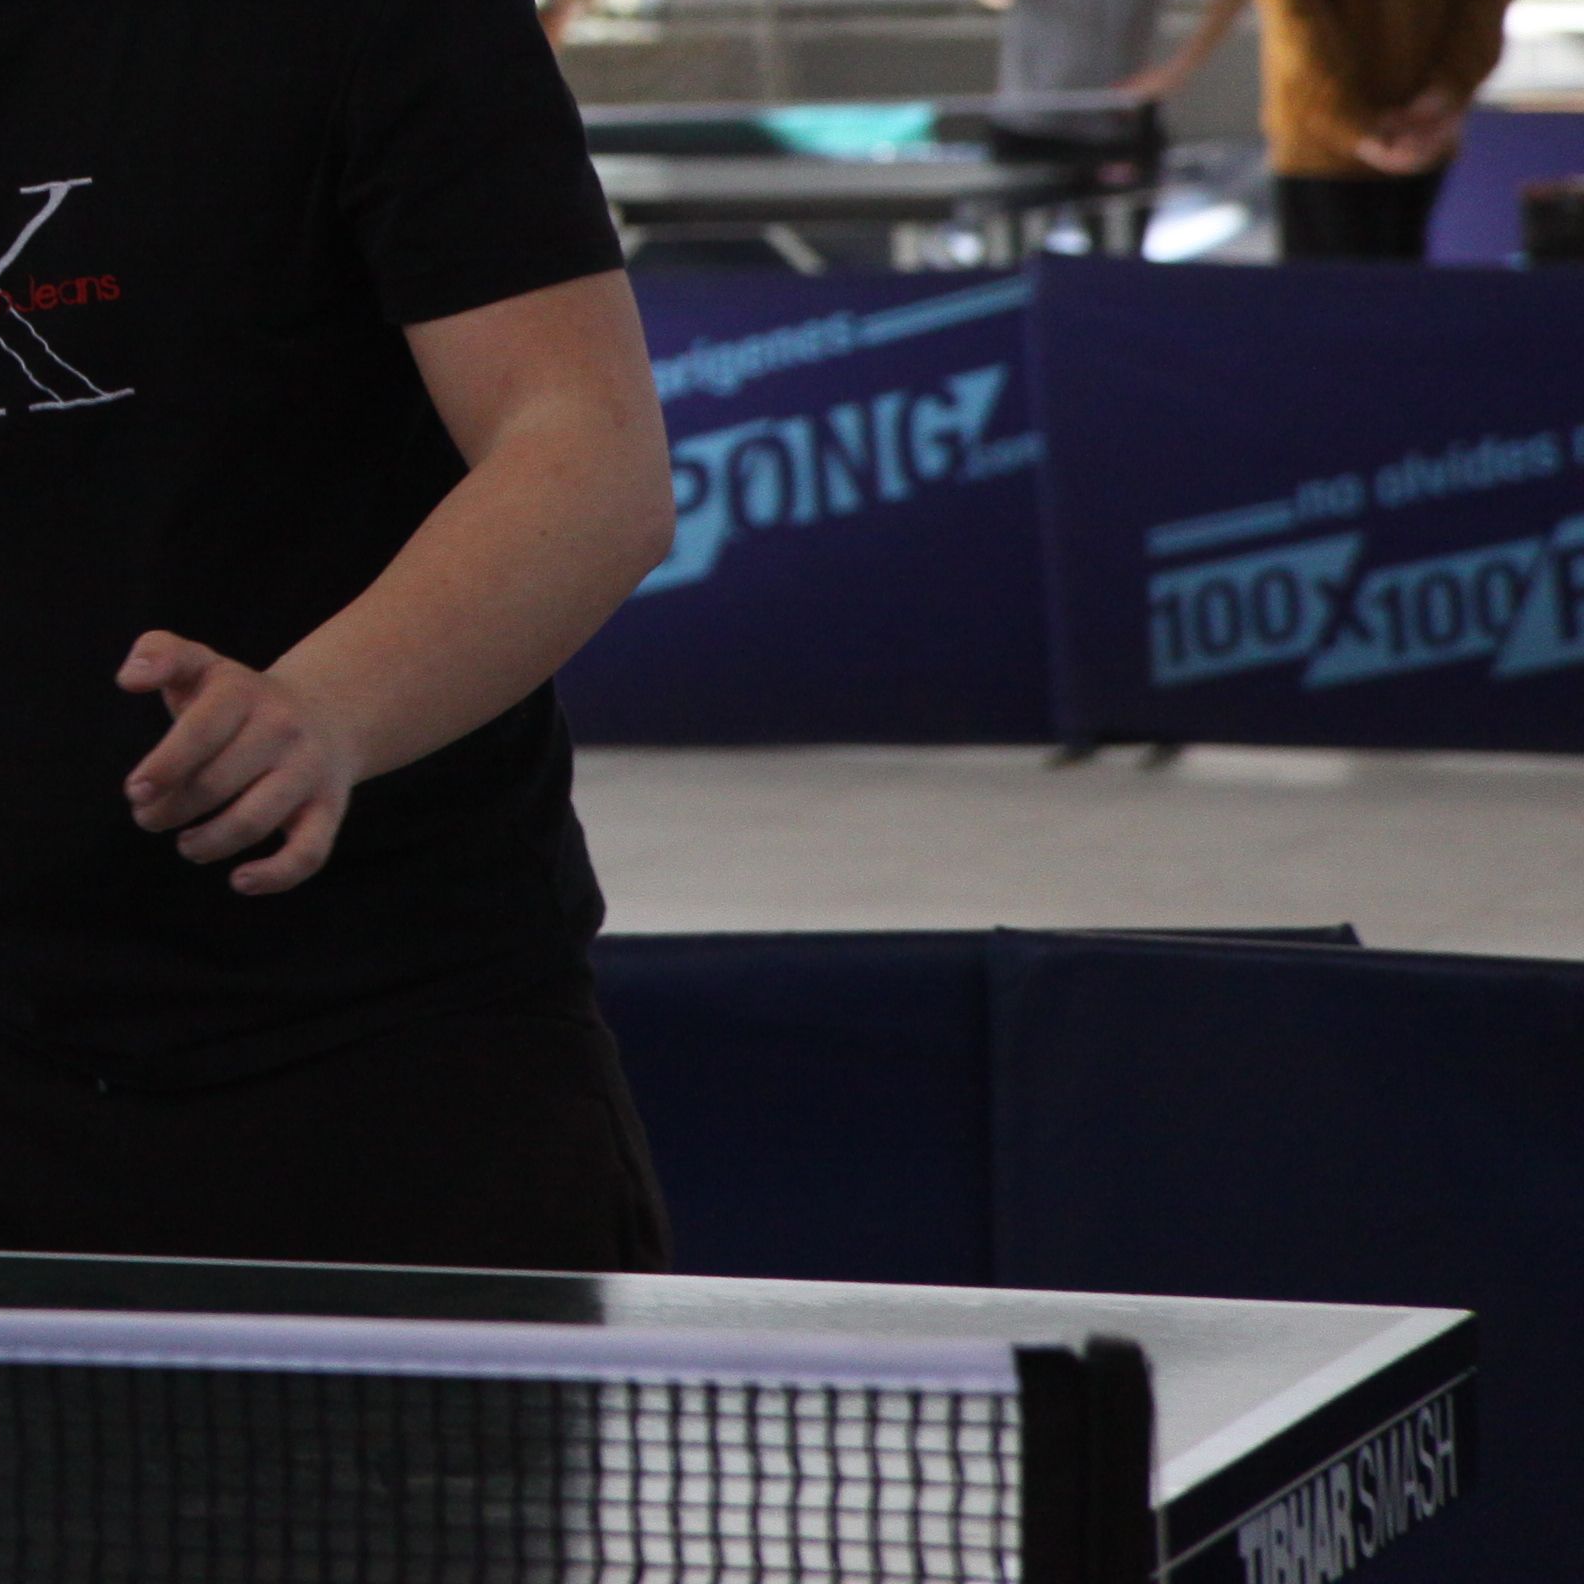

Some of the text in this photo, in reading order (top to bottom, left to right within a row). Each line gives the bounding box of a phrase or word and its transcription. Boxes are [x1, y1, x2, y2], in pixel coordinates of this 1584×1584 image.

[9, 271, 122, 315] Jeans
[1296, 471, 1367, 522] no
[1238, 1392, 1459, 1584] TIBHAR SMASH
